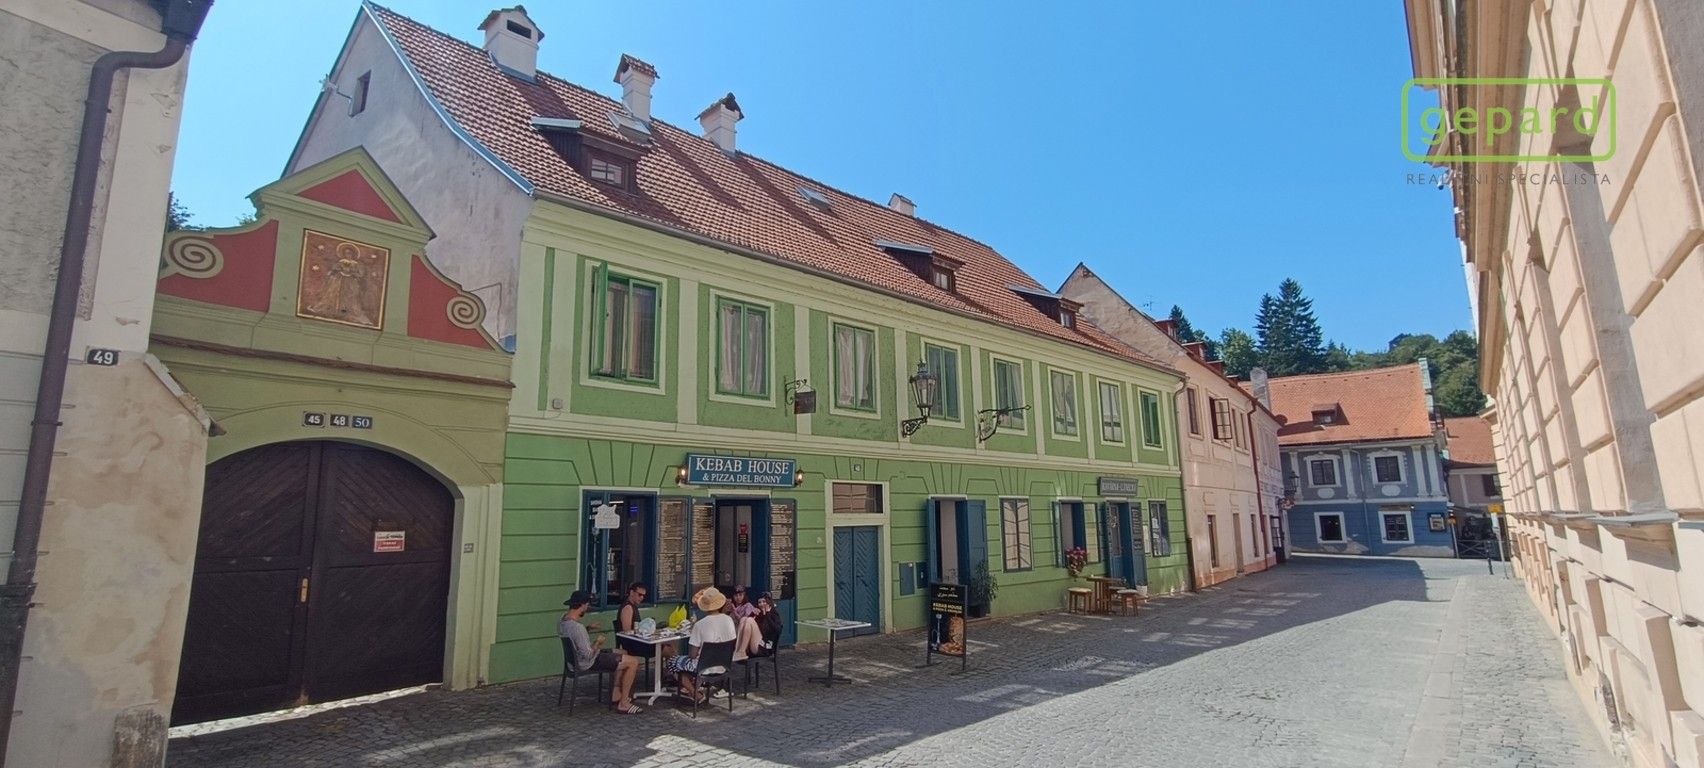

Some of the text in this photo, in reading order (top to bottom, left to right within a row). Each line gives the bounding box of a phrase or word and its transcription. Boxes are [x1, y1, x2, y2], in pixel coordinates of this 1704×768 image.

[93, 350, 114, 365] 49
[308, 415, 321, 424] 45
[333, 415, 346, 426] 48
[355, 417, 370, 428] 50
[696, 457, 790, 474] KEBAB HOUSE
[711, 473, 735, 482] PIZZA
[736, 474, 752, 483] DEL
[754, 475, 782, 484] BONNY
